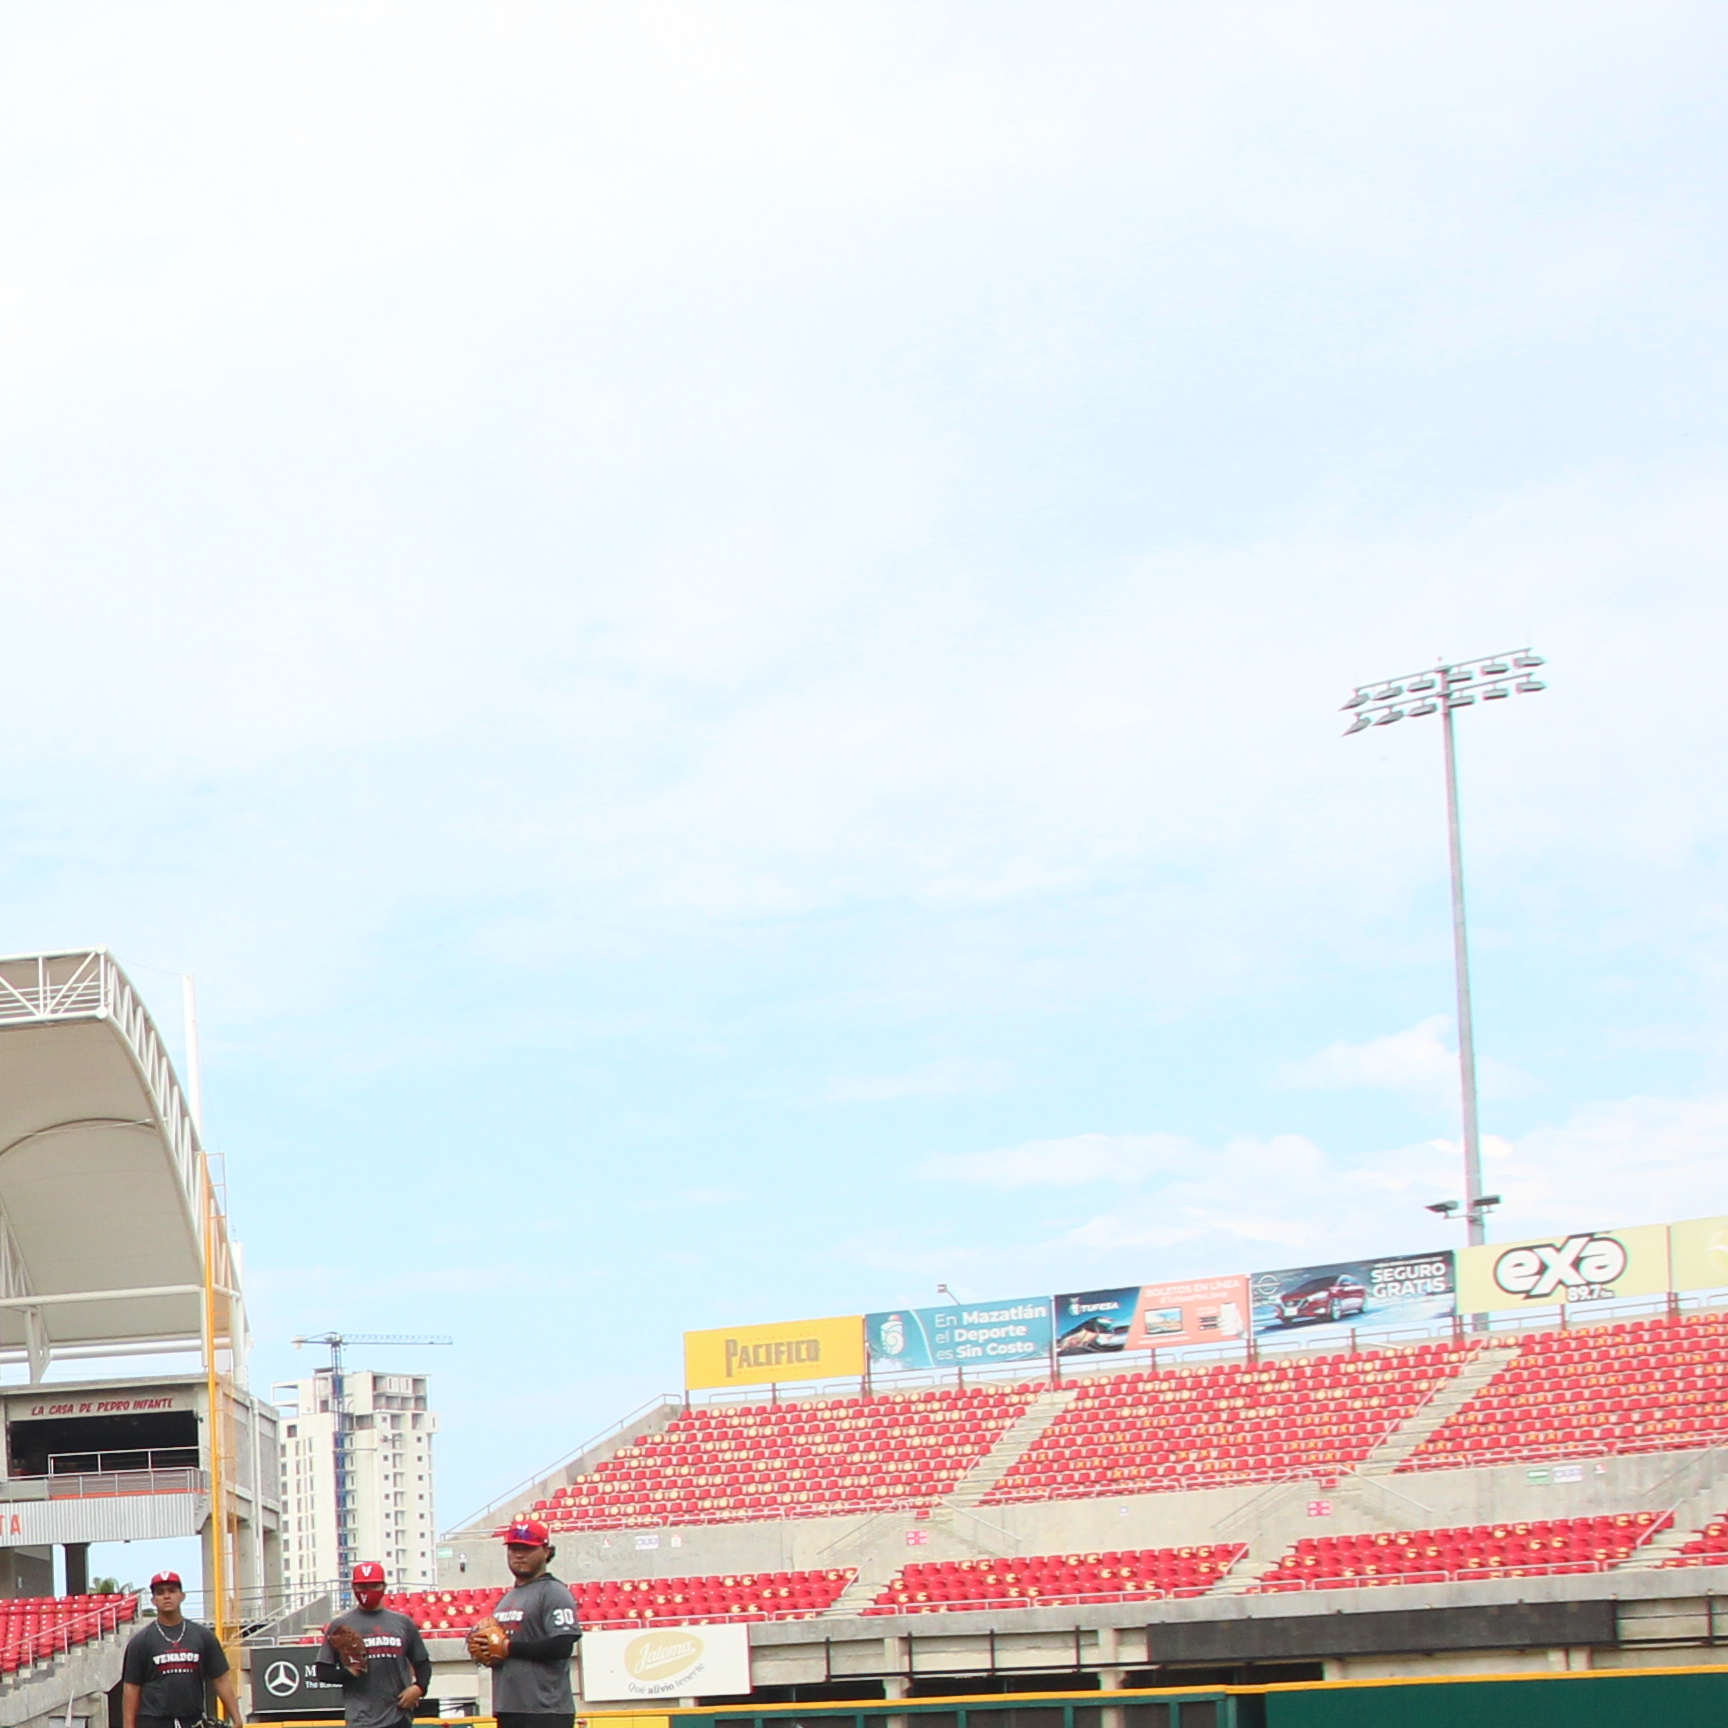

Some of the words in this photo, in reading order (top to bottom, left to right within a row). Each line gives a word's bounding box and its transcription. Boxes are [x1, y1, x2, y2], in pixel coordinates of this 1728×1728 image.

[1371, 1262, 1446, 1283] SEGURO
[1495, 1235, 1626, 1298] exa
[1373, 1277, 1446, 1298] GRATIS
[1566, 1285, 1602, 1302] 89.7
[935, 1313, 958, 1328] En
[962, 1304, 1048, 1325] Mazatlán
[1081, 1302, 1120, 1312] TUFESA
[935, 1331, 949, 1344] el
[954, 1325, 1028, 1343] Deporte
[936, 1350, 954, 1360] es
[956, 1345, 983, 1358] Sin
[986, 1341, 1035, 1354] Costo
[31, 1406, 44, 1416] LA
[48, 1403, 74, 1415] CASA
[79, 1402, 92, 1413] DE
[97, 1400, 130, 1412] PEDRO
[132, 1397, 174, 1410] INFANTE
[553, 1608, 574, 1626] 30
[152, 1652, 199, 1665] VENADOS
[634, 1639, 696, 1674] Jaloma
[628, 1681, 646, 1693] Qué
[647, 1682, 675, 1694] alivio
